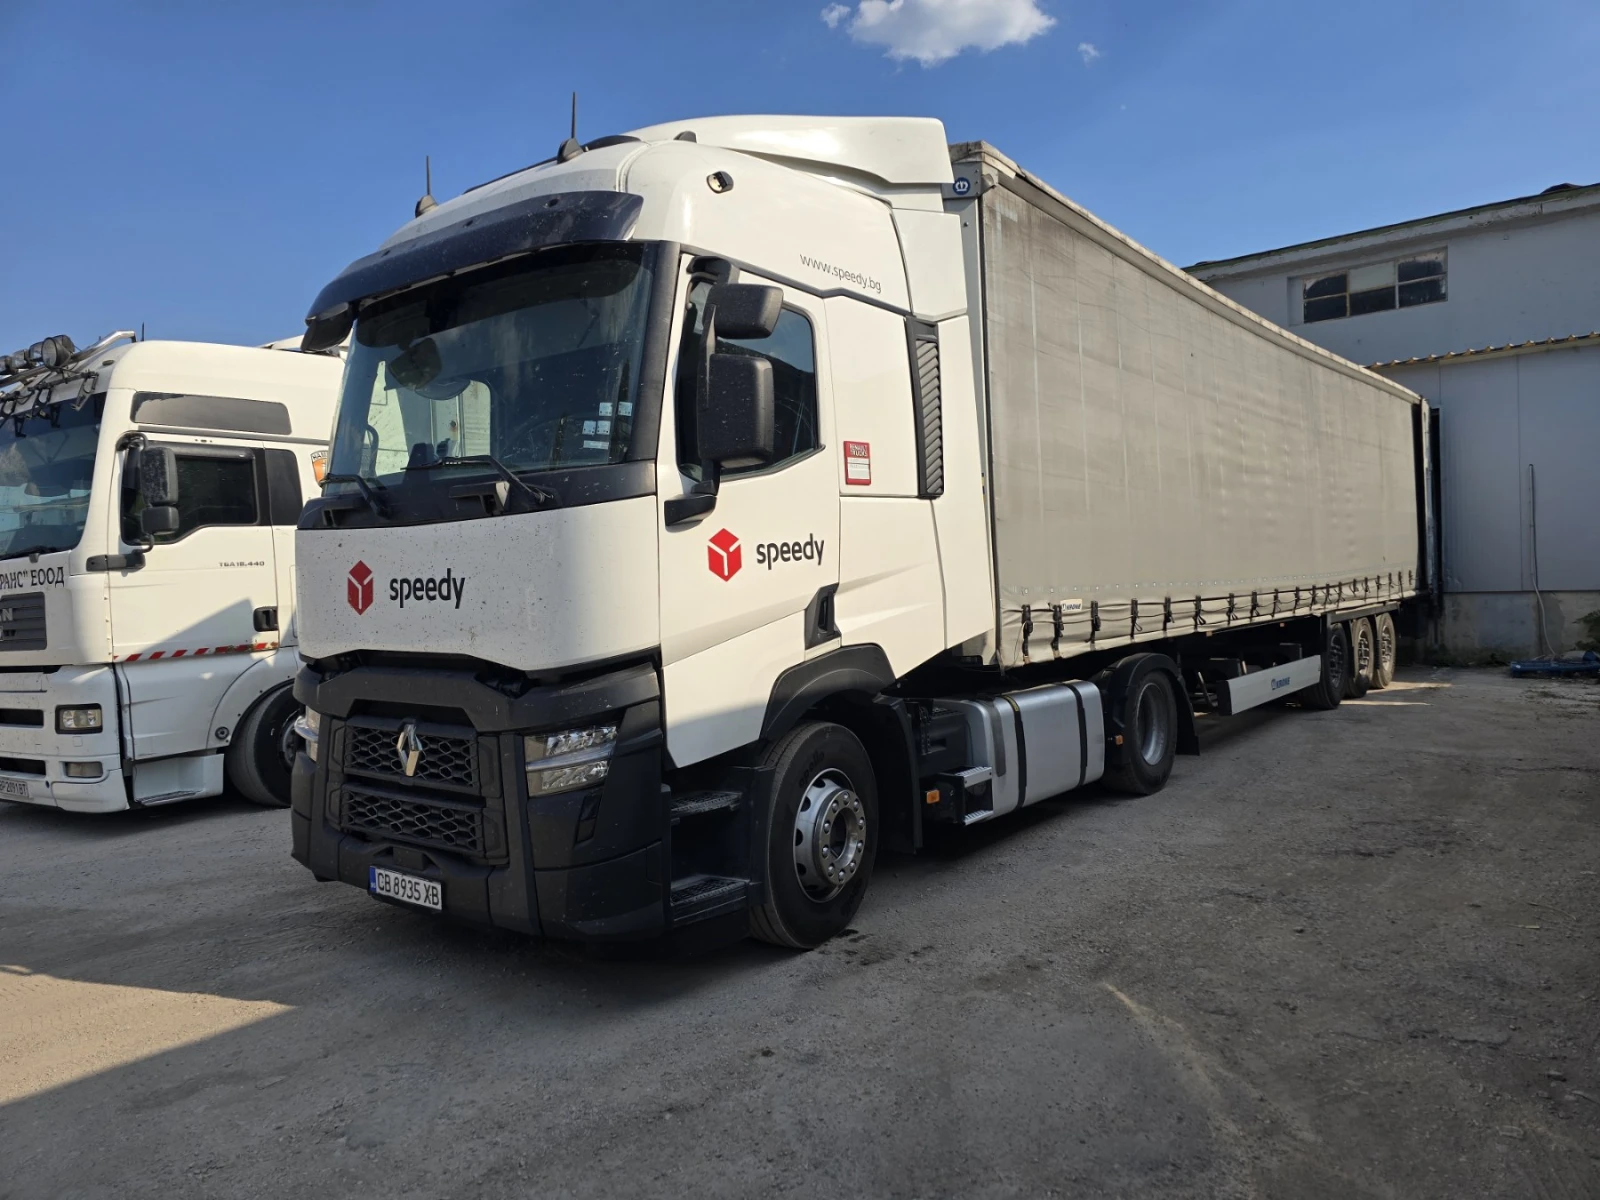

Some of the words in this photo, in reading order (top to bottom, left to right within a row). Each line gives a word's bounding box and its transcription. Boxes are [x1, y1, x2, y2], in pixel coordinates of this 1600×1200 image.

[799, 253, 882, 294] www.speedy.bg
[756, 532, 825, 571] speedy
[31, 566, 65, 588] ЕООД
[389, 567, 466, 609] speedy
[0, 607, 13, 621] N
[393, 876, 421, 901] 8935
[423, 883, 440, 906] XB
